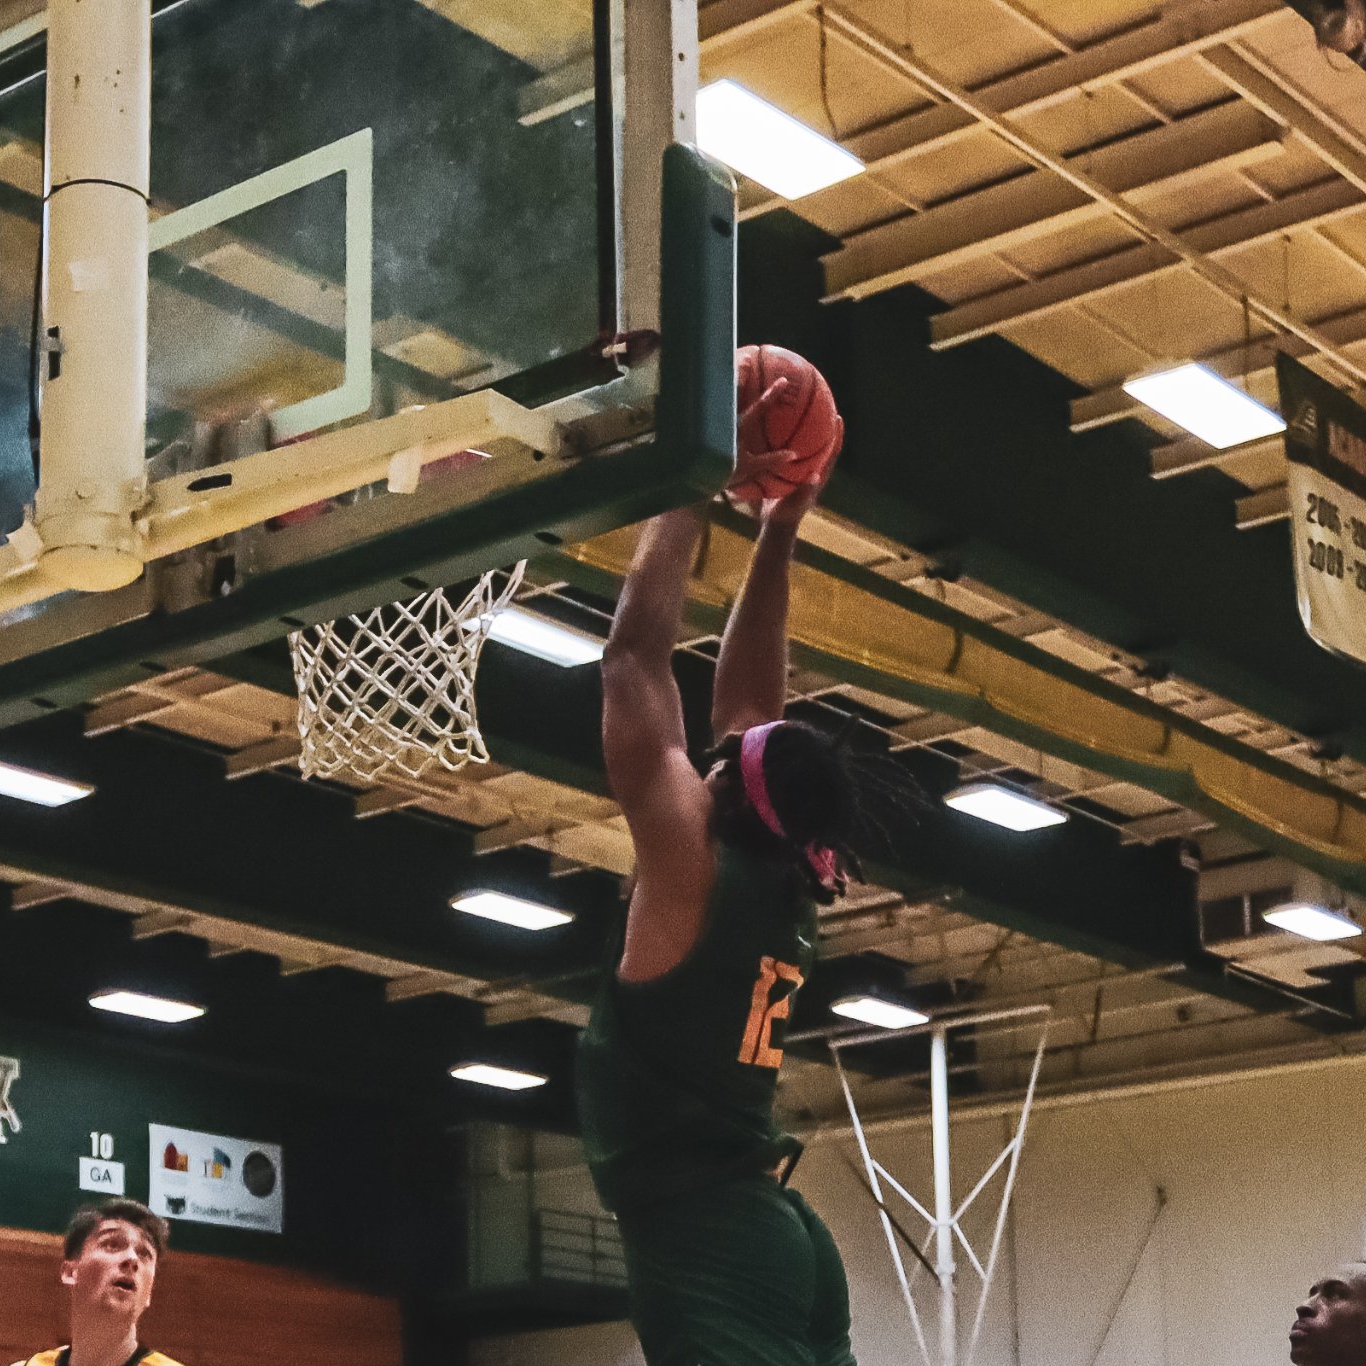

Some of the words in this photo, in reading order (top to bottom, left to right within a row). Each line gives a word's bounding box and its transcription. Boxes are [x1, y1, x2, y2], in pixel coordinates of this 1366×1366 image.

[737, 955, 804, 1068] 12
[90, 1132, 114, 1159] 10
[90, 1167, 112, 1184] GA
